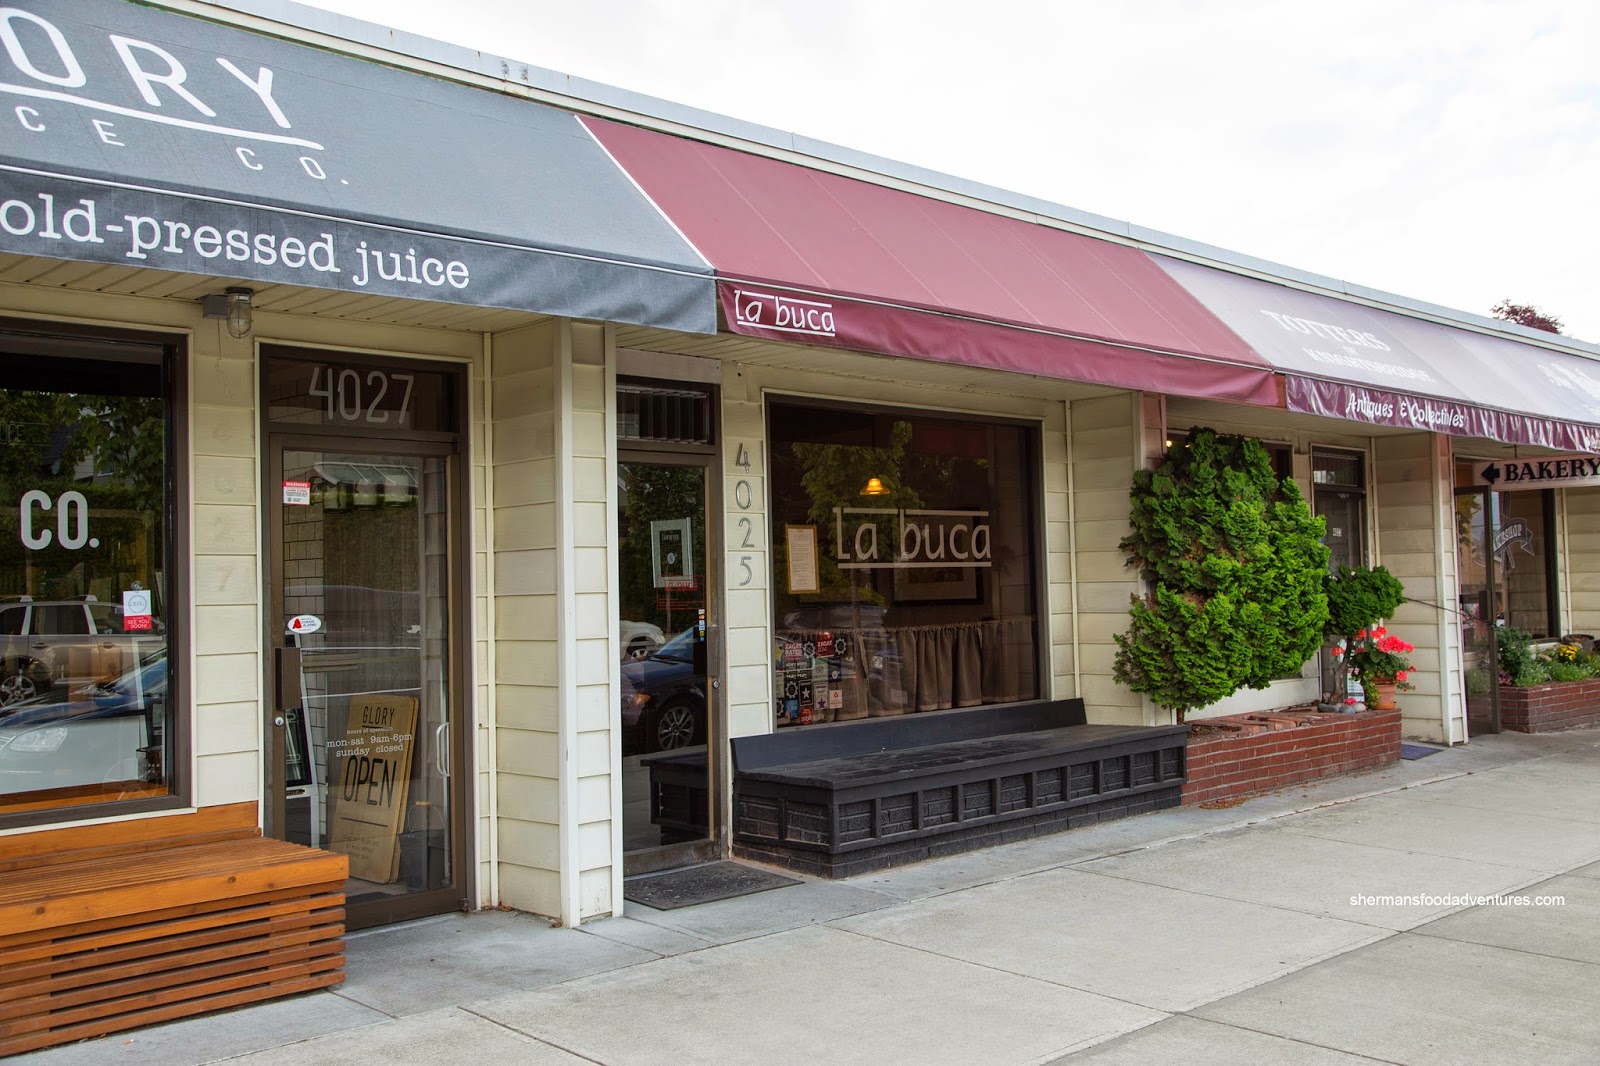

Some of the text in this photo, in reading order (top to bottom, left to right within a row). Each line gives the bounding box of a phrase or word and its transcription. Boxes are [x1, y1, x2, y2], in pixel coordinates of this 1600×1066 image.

[235, 146, 349, 185] CO.
[352, 240, 470, 289] juice
[734, 289, 836, 332] La buca
[308, 367, 415, 424] 4027
[1345, 392, 1394, 419] Antiques
[1504, 457, 1600, 482] BAKERY
[20, 489, 100, 550] CO.
[832, 507, 878, 560] La
[899, 508, 991, 560] buca
[362, 706, 395, 726] GLORY
[327, 733, 412, 748] mon-sat 9am-6pm
[336, 743, 404, 758] sunday closed
[343, 755, 397, 808] OPEN
